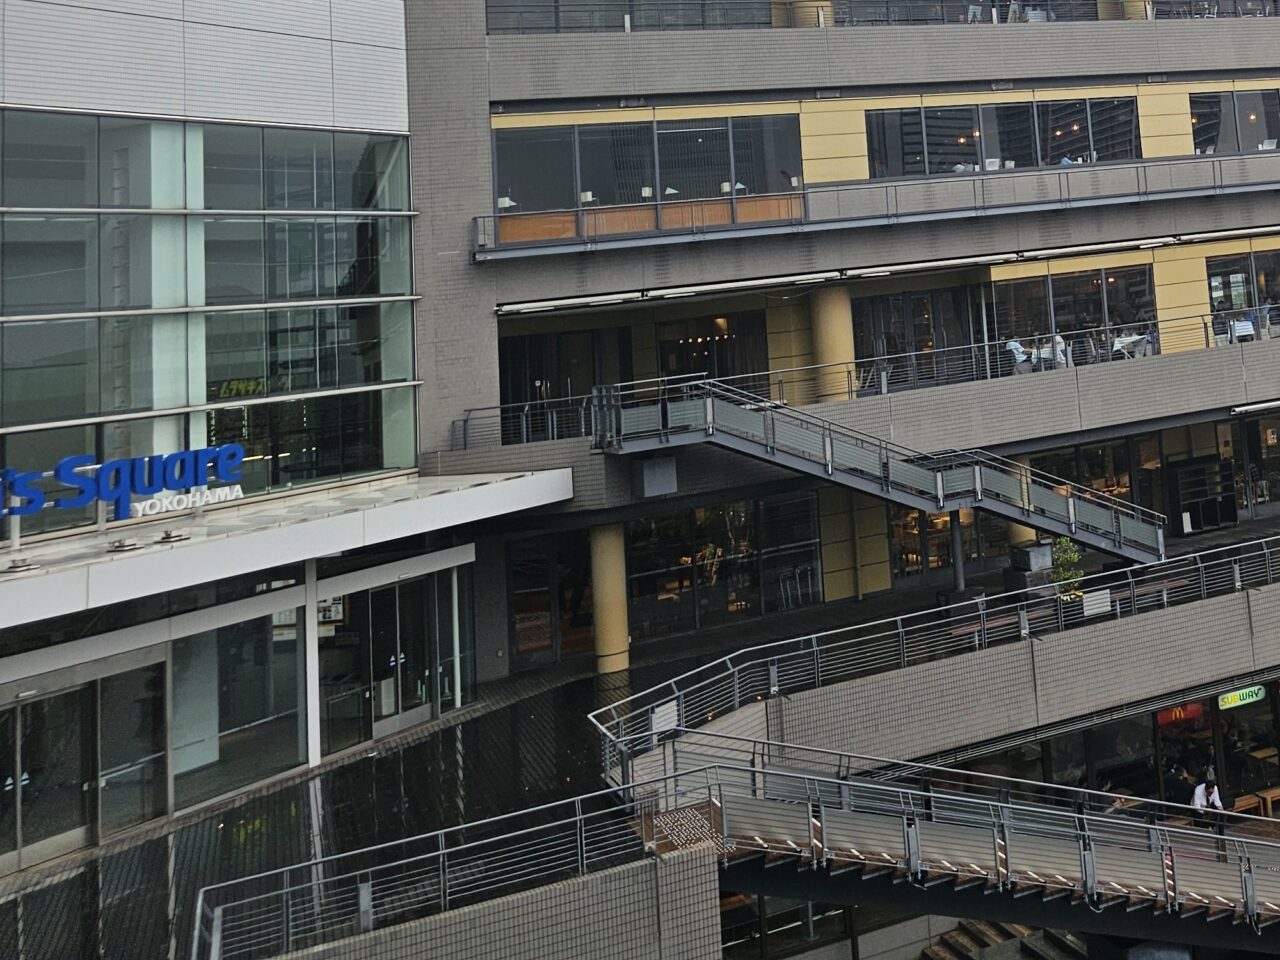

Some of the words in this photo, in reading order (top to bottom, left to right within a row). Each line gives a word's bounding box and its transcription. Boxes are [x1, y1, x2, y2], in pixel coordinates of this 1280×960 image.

[0, 467, 46, 519] 's
[54, 442, 245, 520] Square
[134, 484, 245, 518] YOKOHAMA
[1220, 687, 1262, 707] SUBWAY
